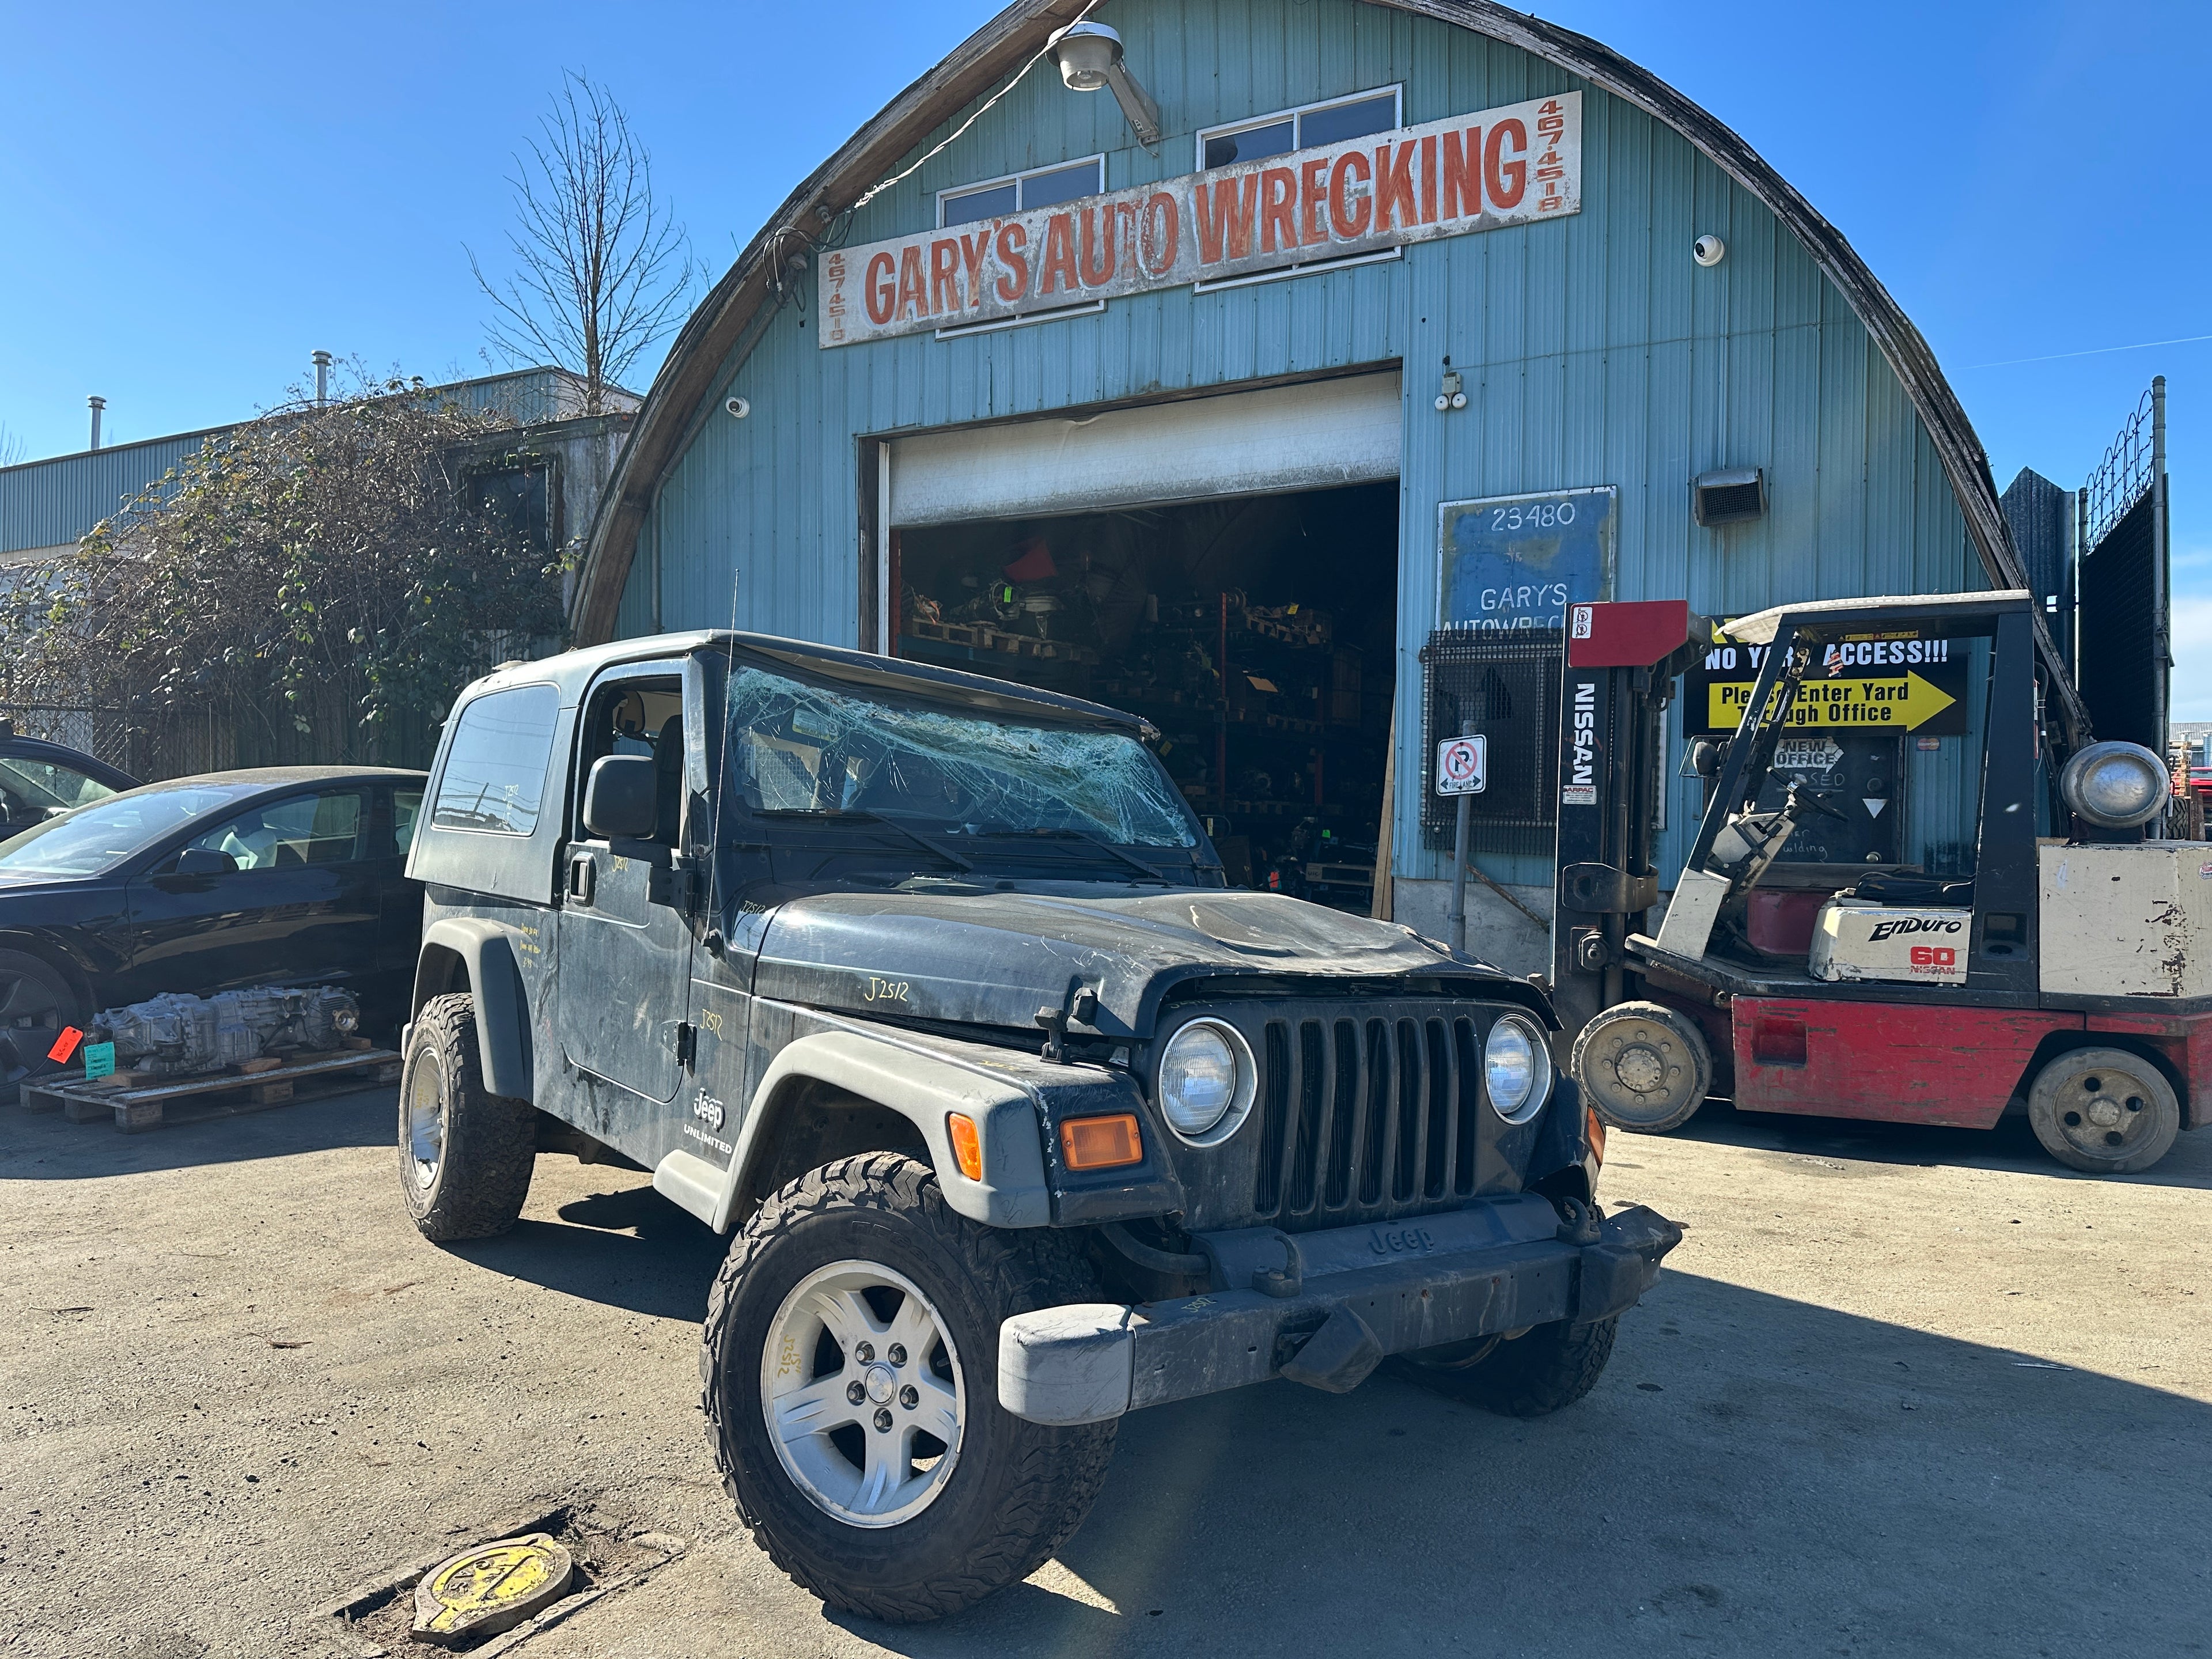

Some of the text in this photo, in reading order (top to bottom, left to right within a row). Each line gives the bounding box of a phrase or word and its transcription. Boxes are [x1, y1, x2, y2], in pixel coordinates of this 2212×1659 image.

[865, 118, 1528, 325] GARY'S AUTO WRECKING
[1491, 502, 1575, 531] 23480
[1481, 584, 1567, 610] GARY'S
[1705, 647, 1736, 670] NO
[1797, 684, 1852, 703] Enter
[1862, 683, 1908, 701] Yard
[1828, 703, 1891, 721] Office
[1572, 683, 1595, 784] NISSAN
[1785, 740, 1826, 752] NEW
[1777, 752, 1835, 766] OFFICE
[1910, 946, 1956, 965] 60
[1910, 965, 1956, 975] NISSAN
[865, 976, 909, 1002] J2512
[694, 1088, 725, 1133] Jeep
[683, 1123, 732, 1154] UNLIMITED
[1368, 1228, 1435, 1255] Jeep
